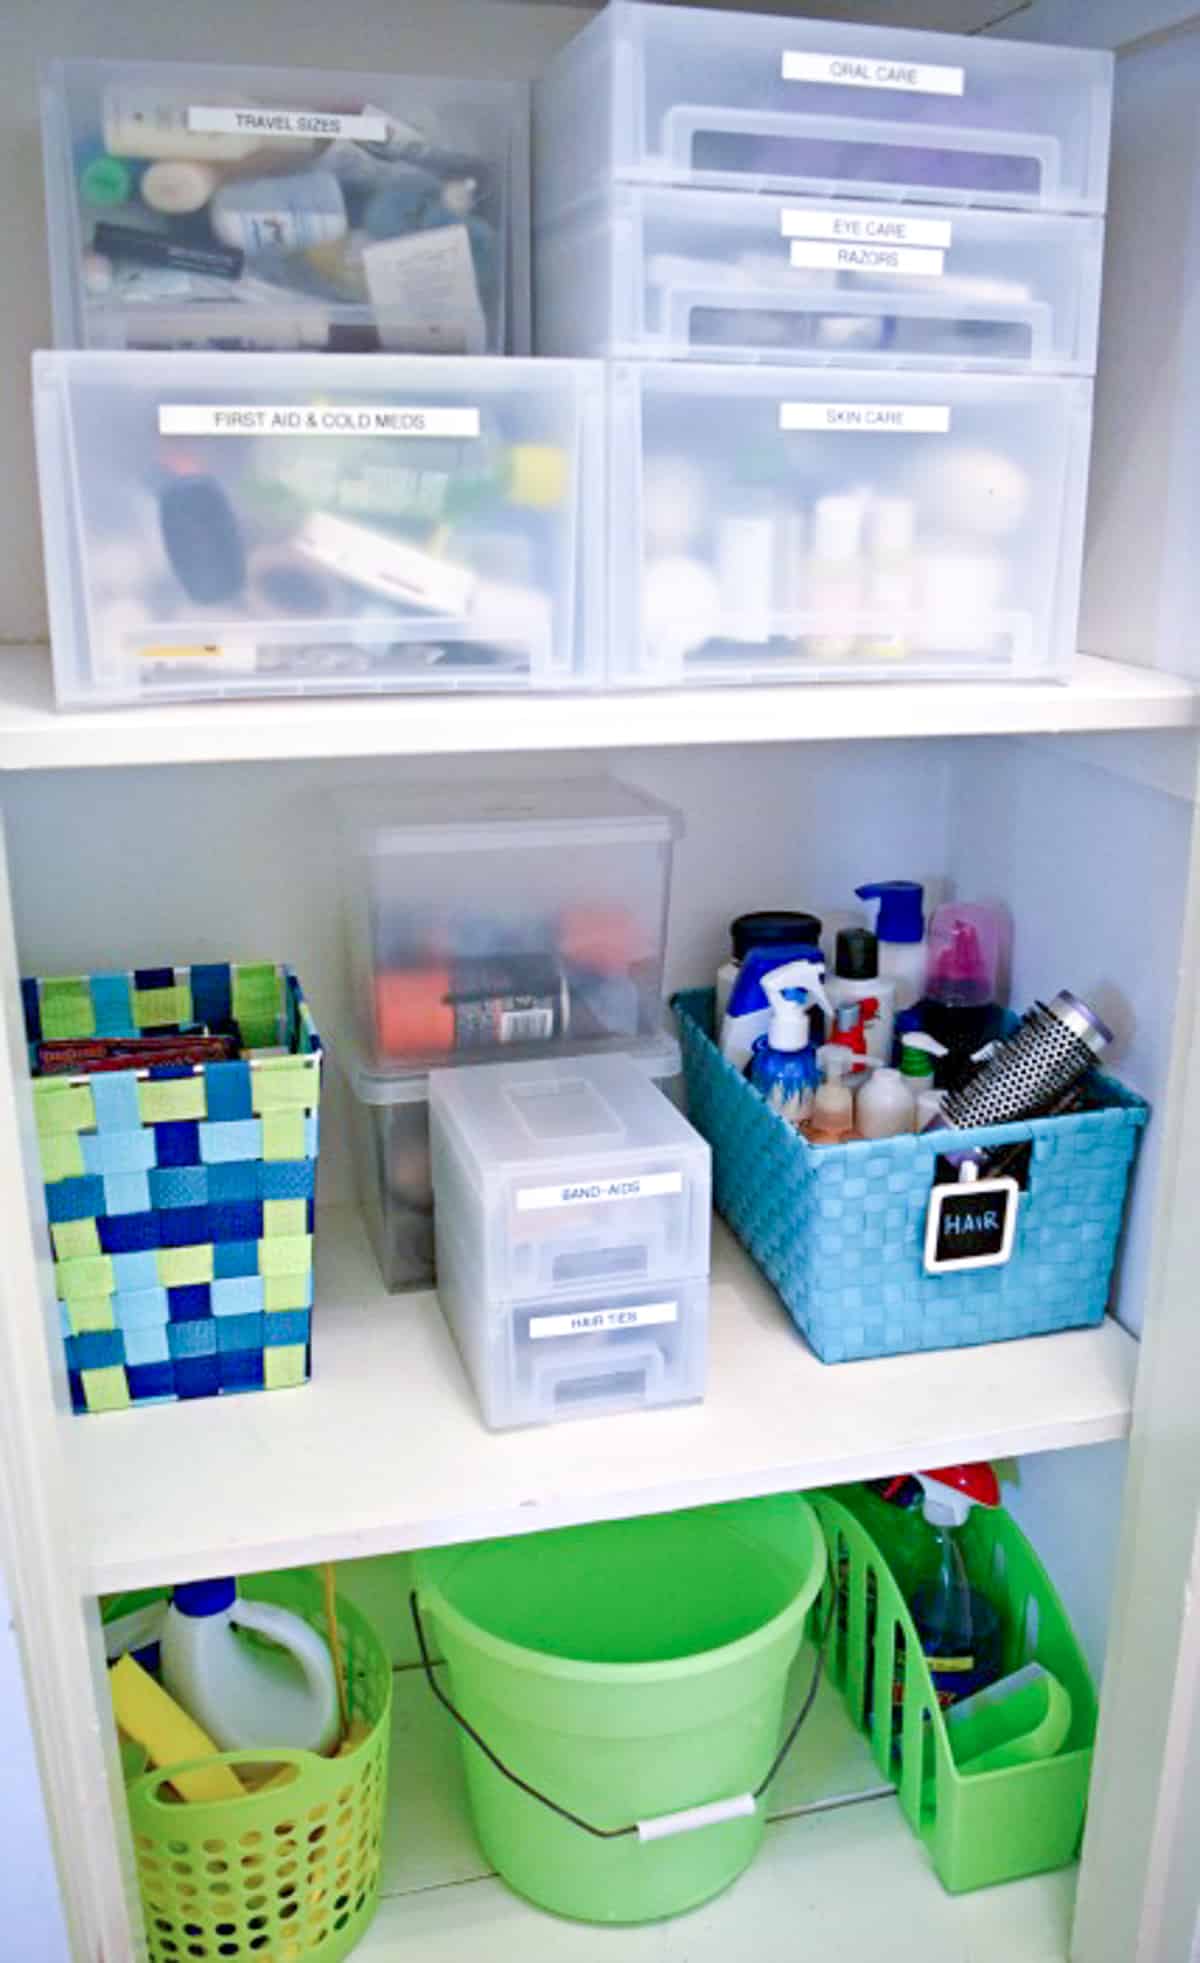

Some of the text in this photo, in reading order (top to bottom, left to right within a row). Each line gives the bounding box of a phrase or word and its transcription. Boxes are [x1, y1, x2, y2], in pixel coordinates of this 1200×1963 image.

[829, 61, 919, 85] ORAL CARE
[235, 112, 341, 133] TRAVEL SIZES
[833, 218, 907, 239] EYE CARE
[838, 249, 899, 267] RAZORS
[214, 411, 425, 430] FIRST AID & COLD MEDS
[826, 408, 904, 426] SKIN CARE
[562, 1180, 640, 1201] BAND-AIDS
[943, 1210, 1000, 1236] HAIR
[571, 1313, 604, 1329] HAIR
